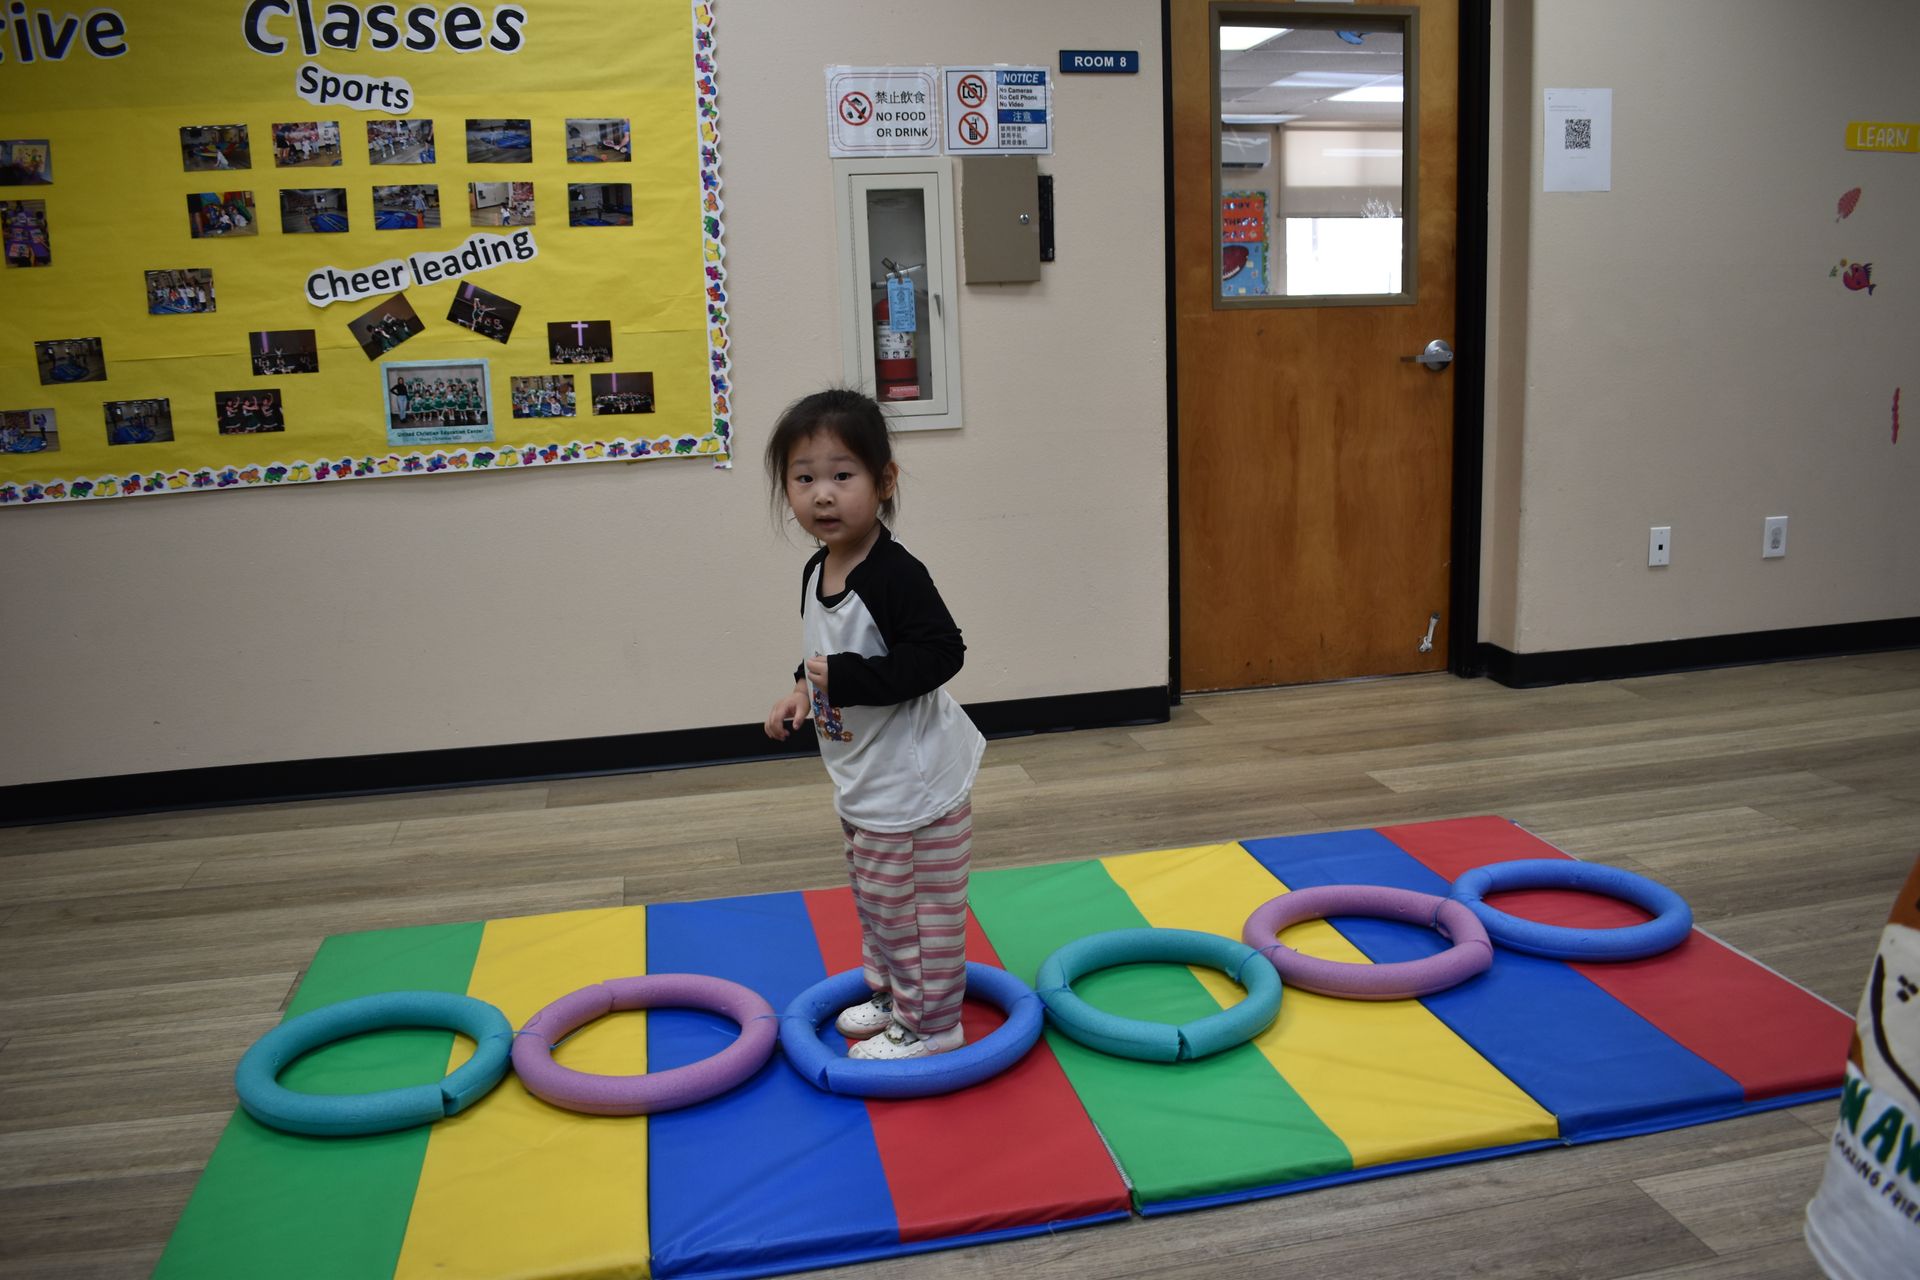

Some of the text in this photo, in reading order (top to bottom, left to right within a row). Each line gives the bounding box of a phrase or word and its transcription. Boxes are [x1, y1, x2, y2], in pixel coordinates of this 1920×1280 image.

[0, 0, 525, 62] ive Classes
[1074, 56, 1127, 68] ROOM 8
[1002, 73, 1040, 84] NOTICE
[299, 65, 410, 109] Sports
[875, 90, 926, 104] 禁止飲食
[876, 111, 926, 122] NO FOOD
[1012, 111, 1032, 123] 注意
[876, 127, 929, 138] OR DRINK
[1857, 125, 1910, 148] LEARN
[306, 230, 535, 300] Cheer leading
